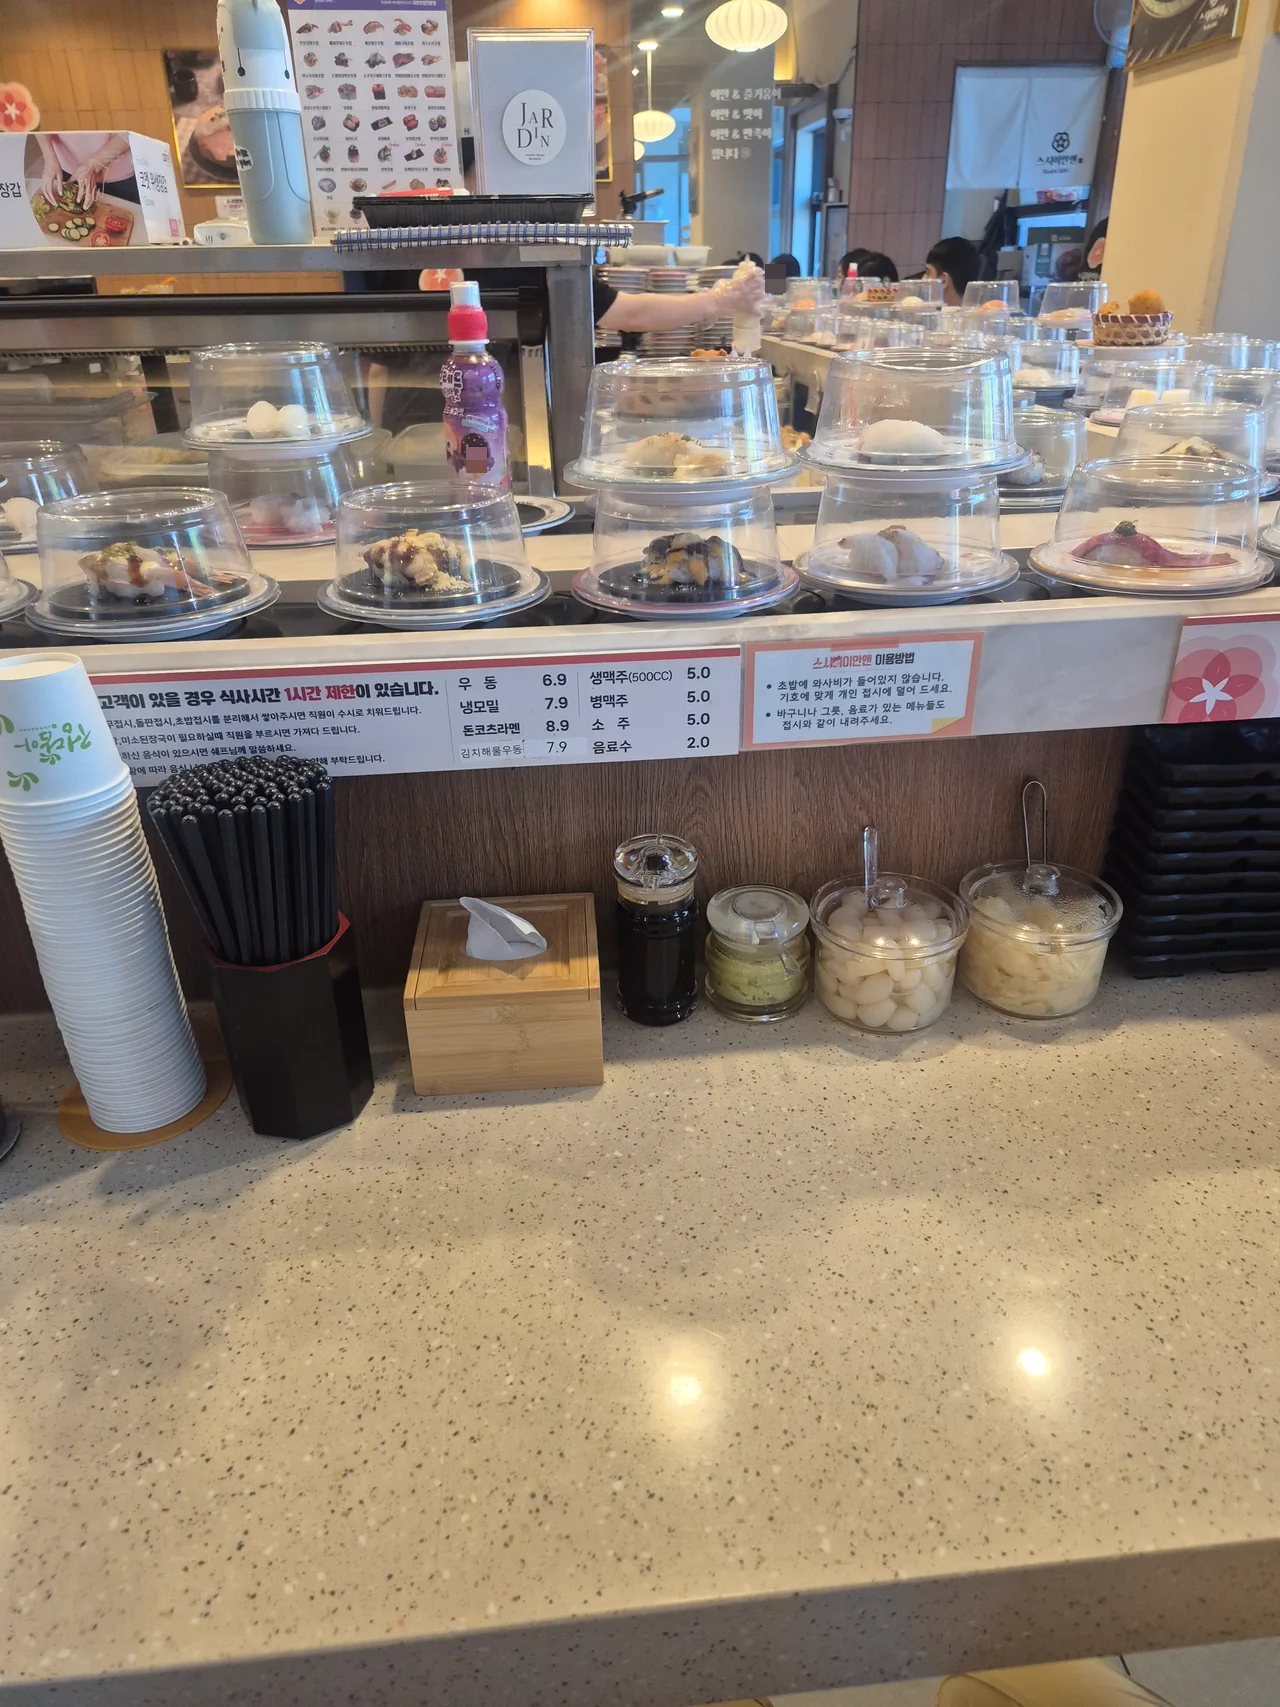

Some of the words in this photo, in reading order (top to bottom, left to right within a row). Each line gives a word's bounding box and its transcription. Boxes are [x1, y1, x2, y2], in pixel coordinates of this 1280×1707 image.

[732, 89, 741, 100] &
[521, 102, 554, 129] JAR
[731, 109, 741, 119] &
[517, 127, 550, 149] DIN
[731, 128, 740, 139] &
[0, 182, 22, 198] 장갑
[875, 652, 915, 666] 이용방법
[542, 673, 567, 687] 6.9
[687, 666, 711, 680] 5.0
[778, 679, 808, 691] 초밥에
[812, 677, 853, 689] 와사비가
[857, 674, 898, 687] 들어있지
[901, 672, 945, 685] 않습니다.
[99, 693, 145, 710] 고객이
[149, 692, 181, 708] 있을
[184, 690, 214, 707] 경우
[219, 688, 282, 705] 식사시간
[284, 685, 322, 702] 1시간
[325, 683, 371, 700] 제한이
[374, 681, 440, 698] 있습니다.
[687, 690, 711, 703] 5.0
[779, 691, 810, 703] 기호에
[814, 690, 834, 702] 맞게
[838, 689, 858, 700] 개인
[861, 686, 892, 699] 접시에
[896, 685, 916, 697] 덜어
[919, 683, 953, 695] 드세요.
[459, 699, 500, 715] 냉모밀
[544, 697, 568, 710] 7.9
[590, 694, 629, 709] 병맥주
[777, 707, 817, 719] 바구니나
[820, 705, 844, 718] 그릇,
[848, 703, 879, 716] 음료가
[882, 702, 902, 713] 있는
[906, 699, 946, 712] 메뉴들도
[223, 710, 260, 724] 분리해서
[261, 709, 307, 723] 쌓아주시면
[308, 707, 335, 720] 직원이
[337, 705, 364, 719] 수시로
[366, 704, 422, 718] 치워드립니다.
[687, 712, 710, 726] 5.0
[462, 722, 521, 737] 돈코츠라멘
[546, 719, 570, 732] 8.9
[782, 719, 813, 732] 접시와
[816, 718, 836, 729] 같이
[839, 715, 893, 728] 내려주세요.
[178, 729, 224, 743] 필요하실때
[226, 728, 253, 741] 직원을
[255, 727, 291, 740] 부르시면
[293, 726, 320, 738] 가져다
[322, 724, 360, 737] 드립니다.
[546, 741, 568, 754] 7.9
[592, 740, 633, 755] 음료수
[687, 736, 710, 750] 2.0
[142, 747, 170, 760] 음식이
[172, 745, 209, 758] 있으시면
[210, 743, 247, 756] 쉐프님께
[248, 742, 297, 755] 말씀하세요.
[460, 744, 523, 759] 김치해물우동
[331, 754, 385, 765] 부탁드립니다.
[149, 765, 167, 775] 따라
